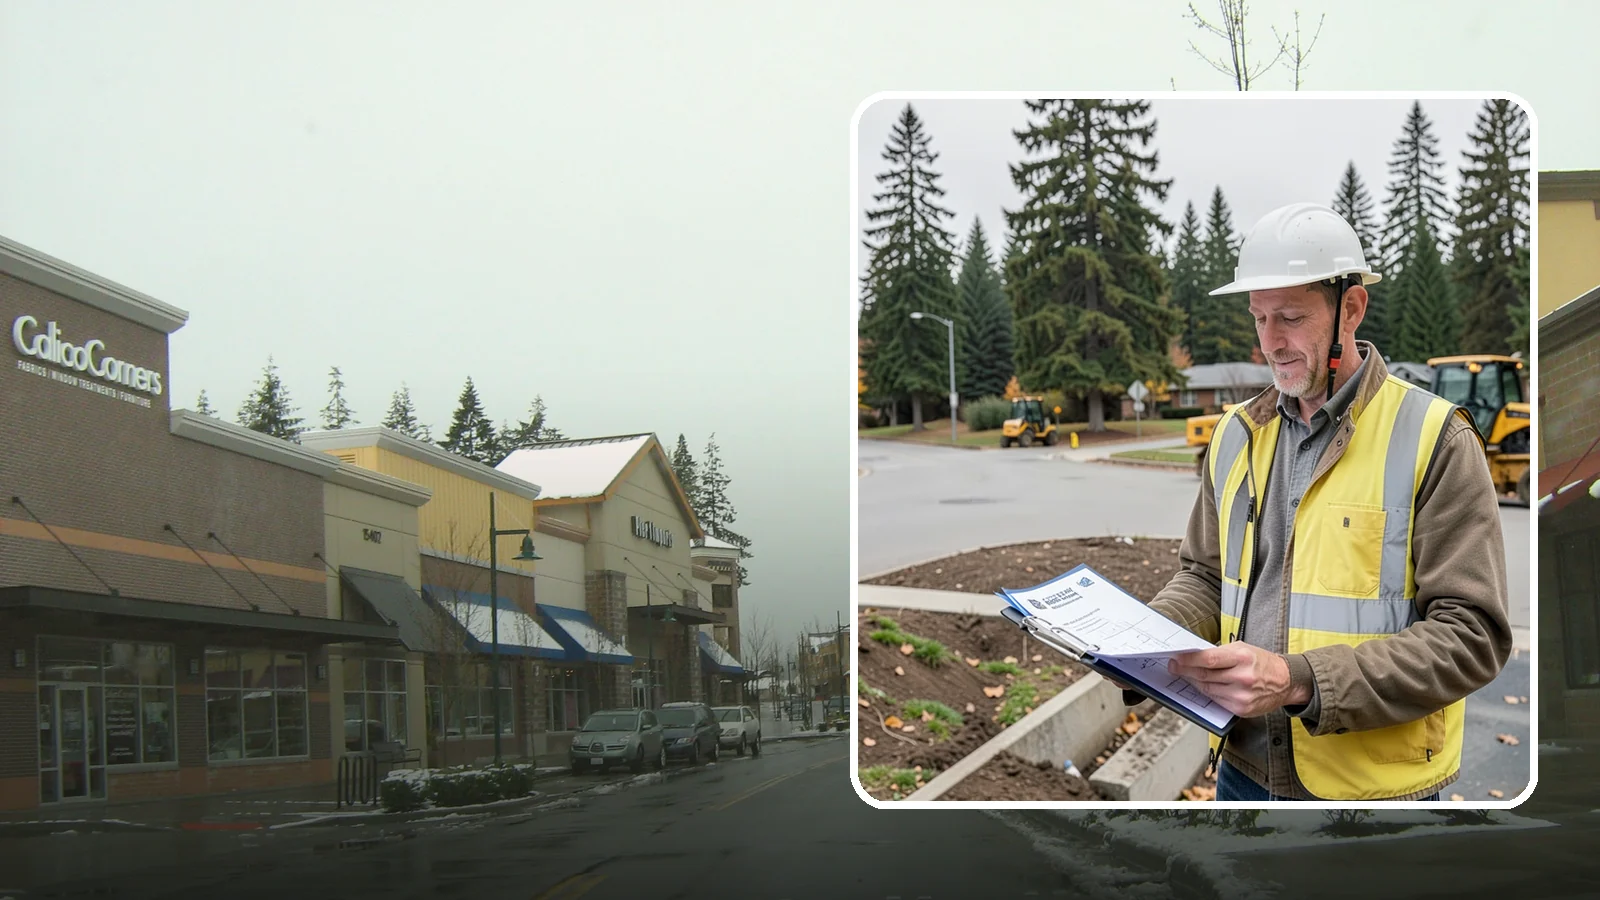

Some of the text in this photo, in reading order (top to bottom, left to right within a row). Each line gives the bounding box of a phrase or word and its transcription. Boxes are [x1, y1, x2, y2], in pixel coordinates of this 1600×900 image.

[17, 360, 47, 377] FABRICS
[51, 370, 78, 387] WINDOW
[78, 378, 117, 399] TREATMENTS
[120, 391, 151, 409] FURNITURE
